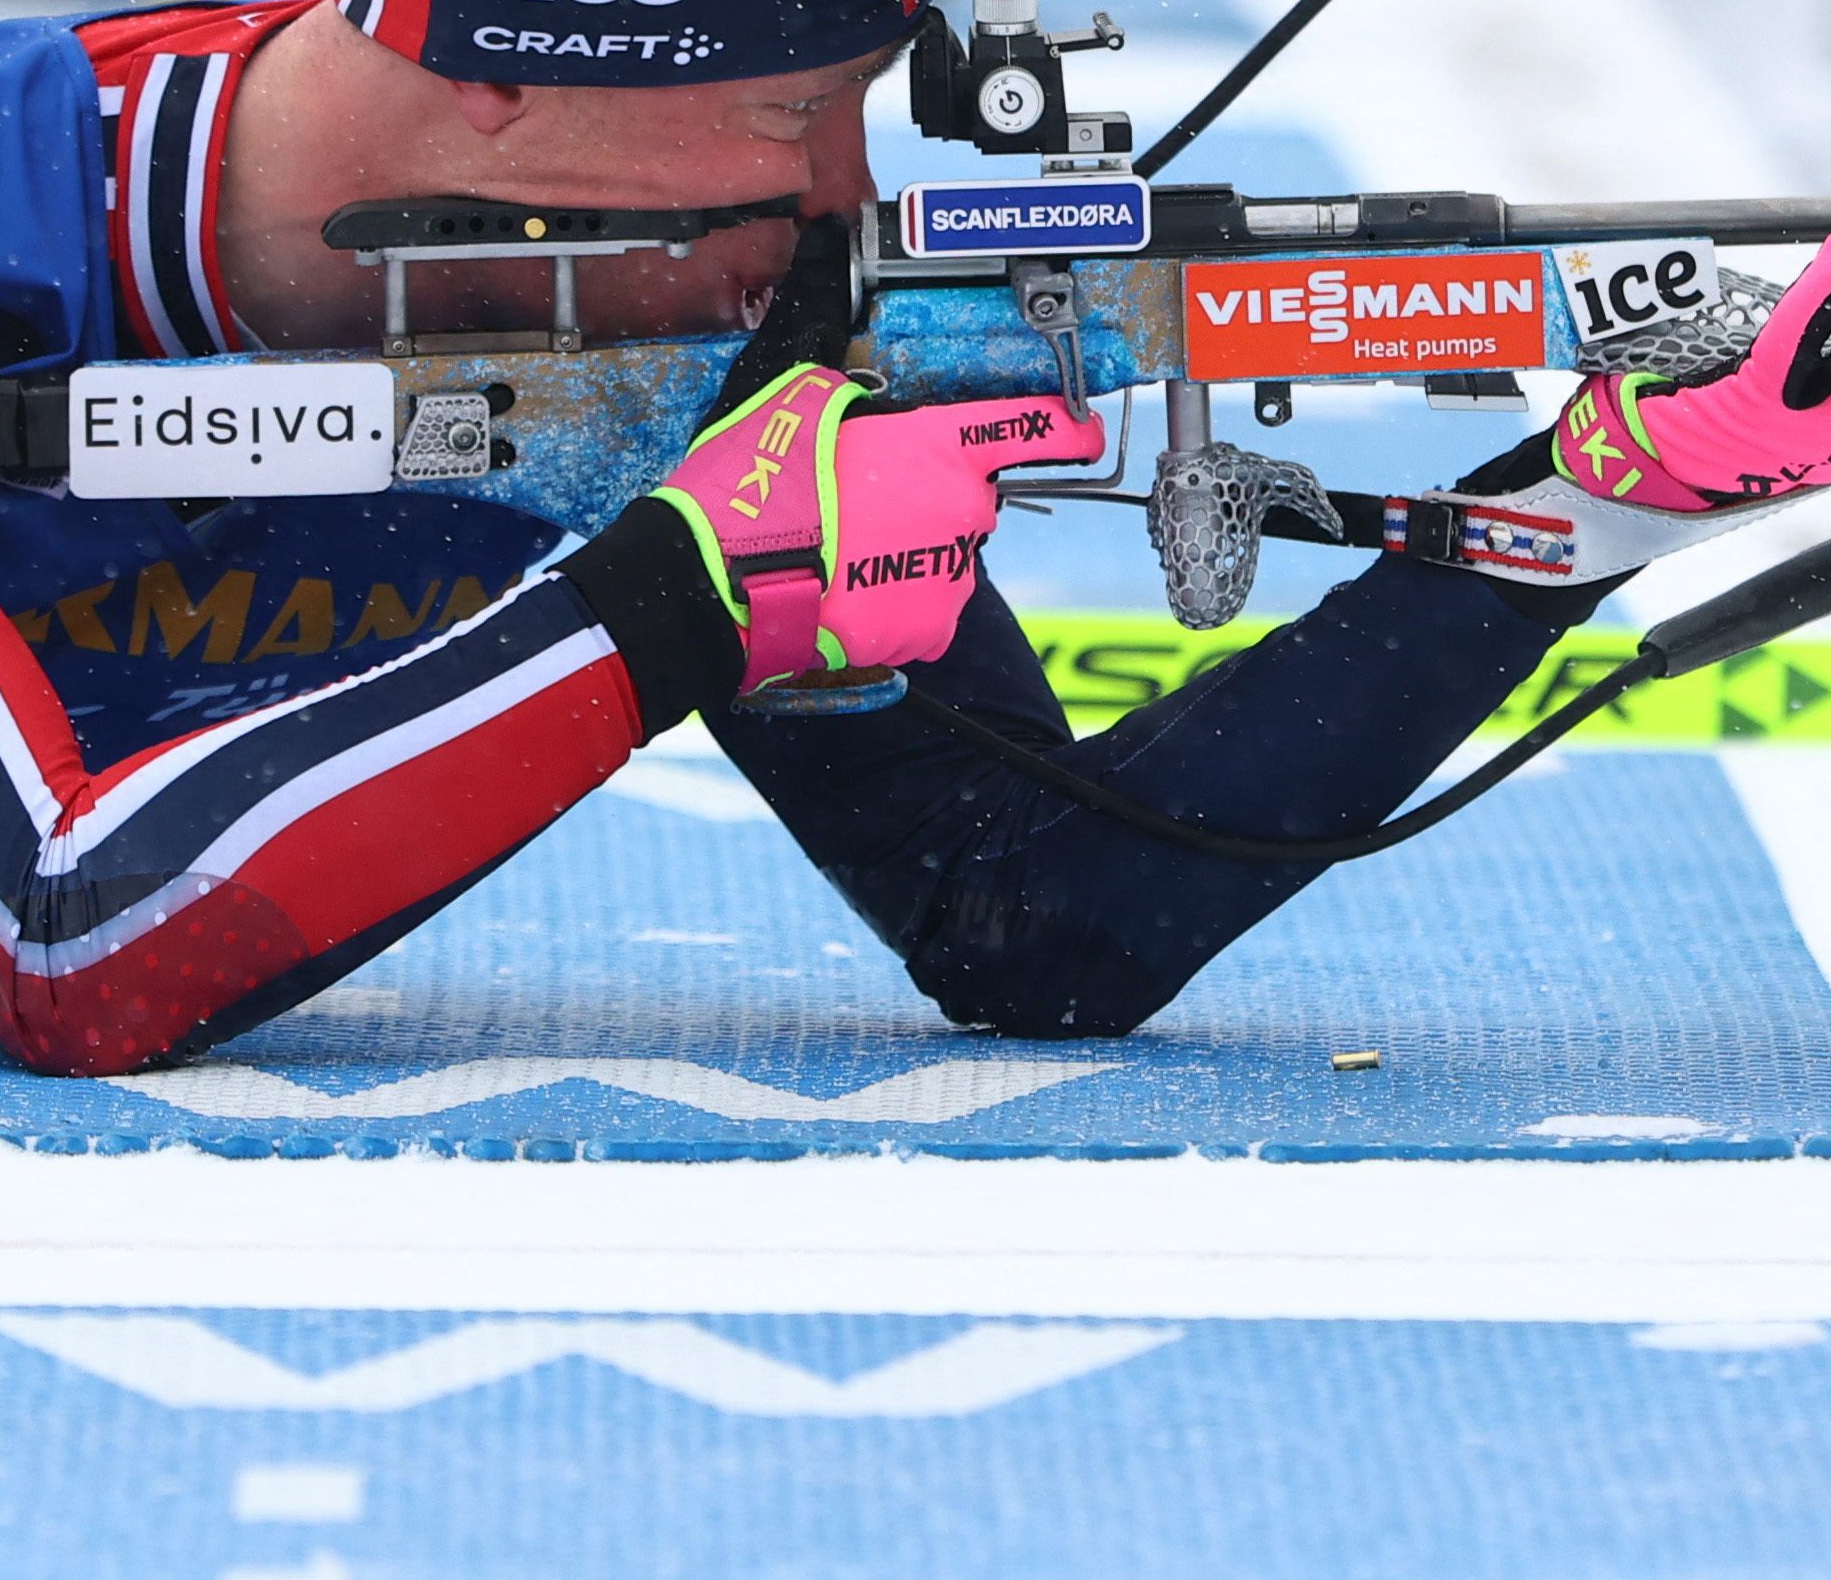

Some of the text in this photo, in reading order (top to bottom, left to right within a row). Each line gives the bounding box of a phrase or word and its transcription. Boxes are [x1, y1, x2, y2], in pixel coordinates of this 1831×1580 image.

[473, 26, 670, 61] CRAFT
[931, 200, 1134, 231] SCANFLEXDØRA
[1196, 269, 1533, 345] VIESSMANN
[1353, 334, 1497, 362] Heat pumps
[728, 373, 832, 520] LEKI
[1568, 388, 1643, 498] EKI
